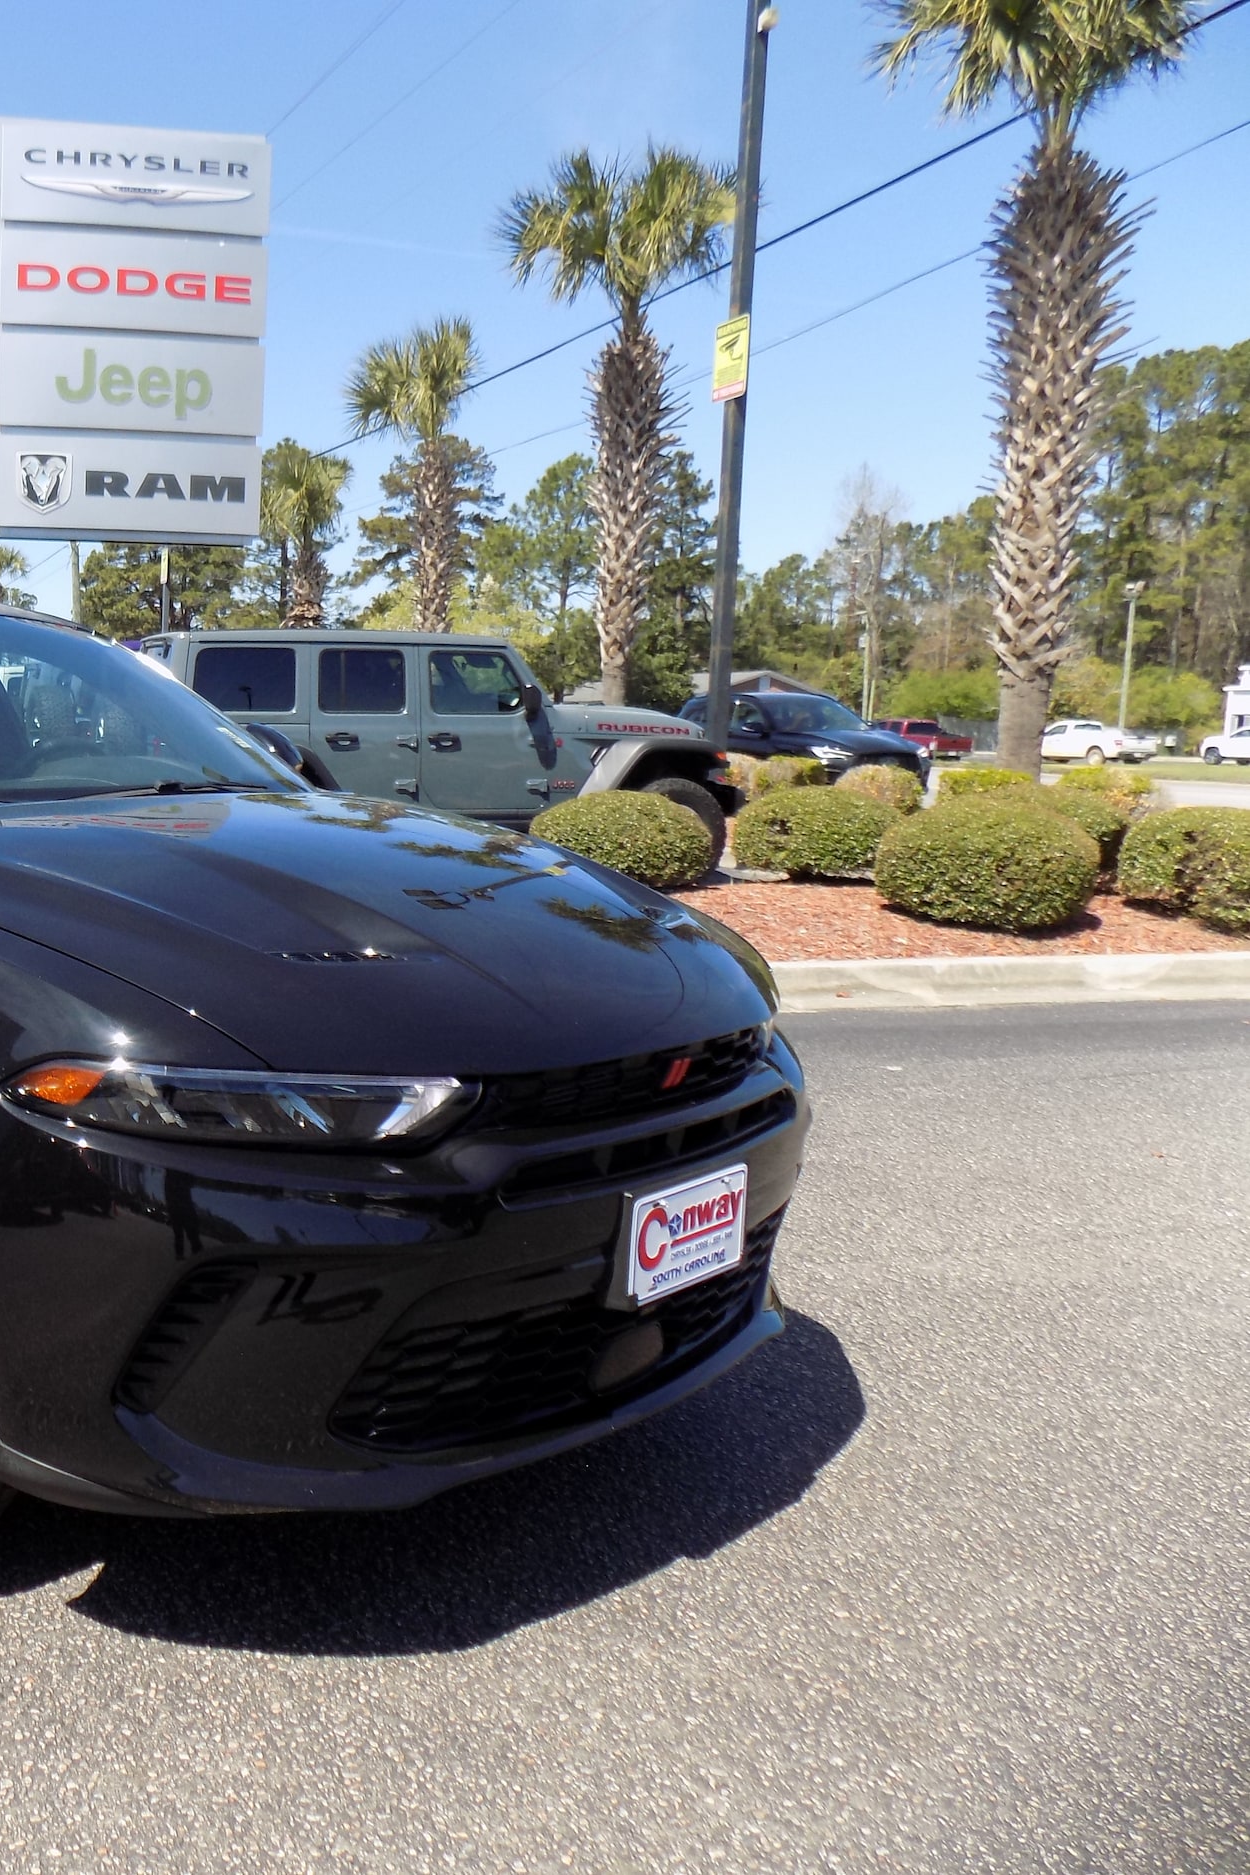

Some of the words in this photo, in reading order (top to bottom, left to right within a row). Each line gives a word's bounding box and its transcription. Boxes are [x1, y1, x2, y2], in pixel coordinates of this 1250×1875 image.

[24, 149, 249, 178] CHRYSLER
[18, 263, 252, 304] DODGE
[55, 348, 212, 420] Jeep
[85, 470, 245, 503] RAM
[597, 723, 691, 736] RUBICON
[652, 1265, 682, 1285] SOUTH
[684, 1248, 726, 1272] CAROLINA
